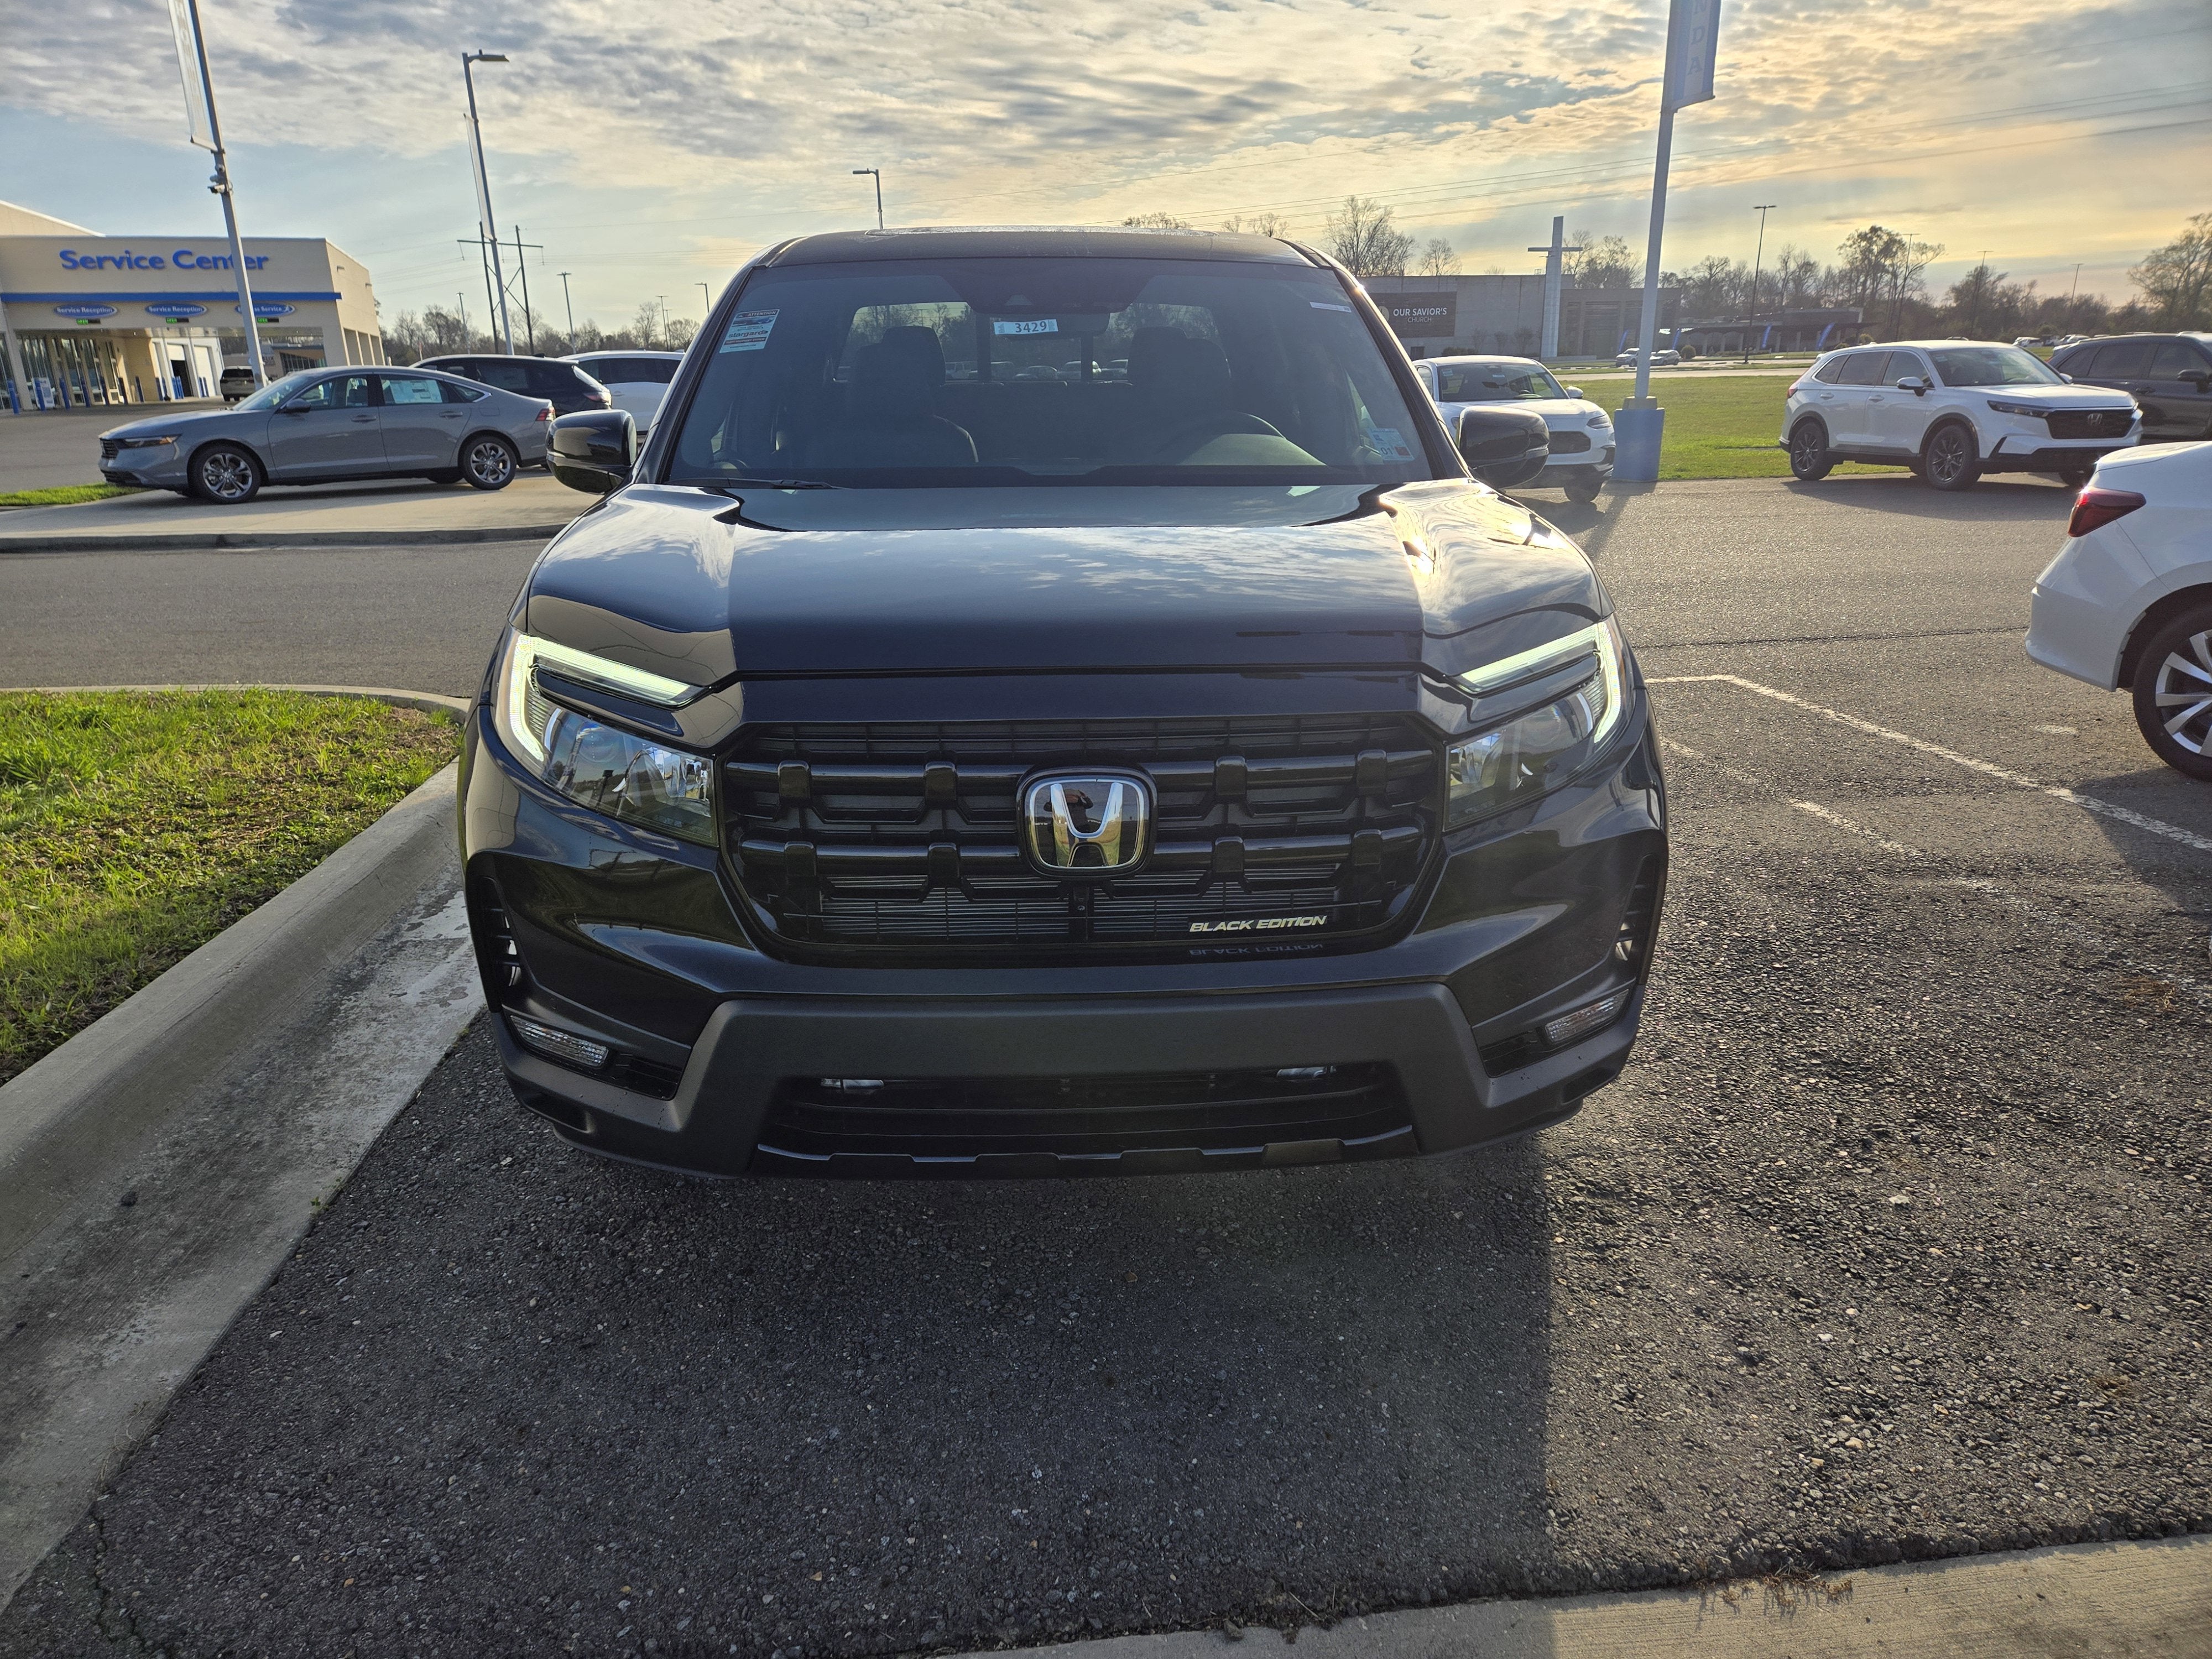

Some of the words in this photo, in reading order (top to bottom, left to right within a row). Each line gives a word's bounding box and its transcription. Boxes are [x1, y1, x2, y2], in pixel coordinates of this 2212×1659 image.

[59, 249, 165, 270] Service
[1393, 308, 1410, 317] OUR
[1412, 307, 1447, 316] SAVIOR'S
[1015, 321, 1047, 333] 3429
[1380, 447, 1394, 455] 01
[1189, 920, 1255, 932] BLACK
[1256, 915, 1327, 930] EDITION
